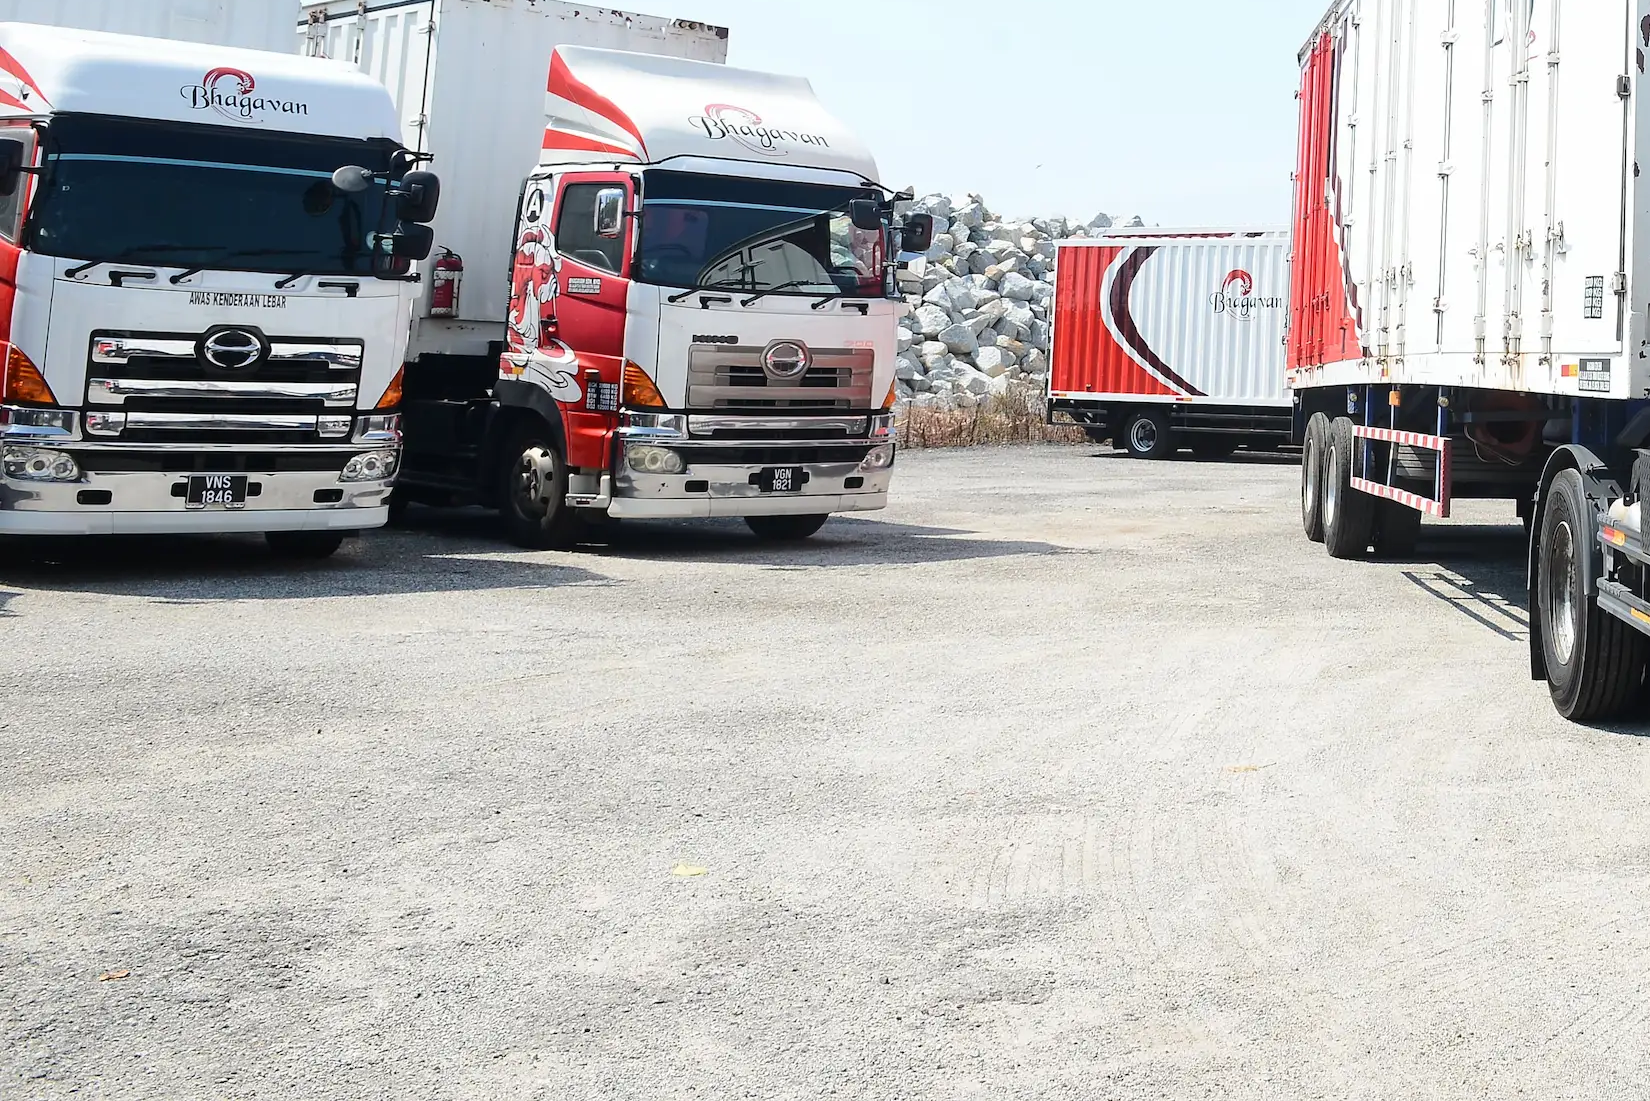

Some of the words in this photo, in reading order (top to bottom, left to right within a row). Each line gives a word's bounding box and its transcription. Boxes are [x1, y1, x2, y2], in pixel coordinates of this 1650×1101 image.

[181, 85, 308, 117] Bhagavan
[688, 116, 830, 148] Bhagavan
[527, 190, 541, 217] A
[189, 291, 210, 305] AWAS
[213, 292, 259, 307] KENDERAAN
[263, 294, 286, 308] LEBAR
[1209, 291, 1282, 316] Bhagavan
[774, 468, 792, 479] VGN
[206, 476, 231, 489] VNS
[772, 479, 792, 490] 1821
[201, 490, 233, 503] 1846
